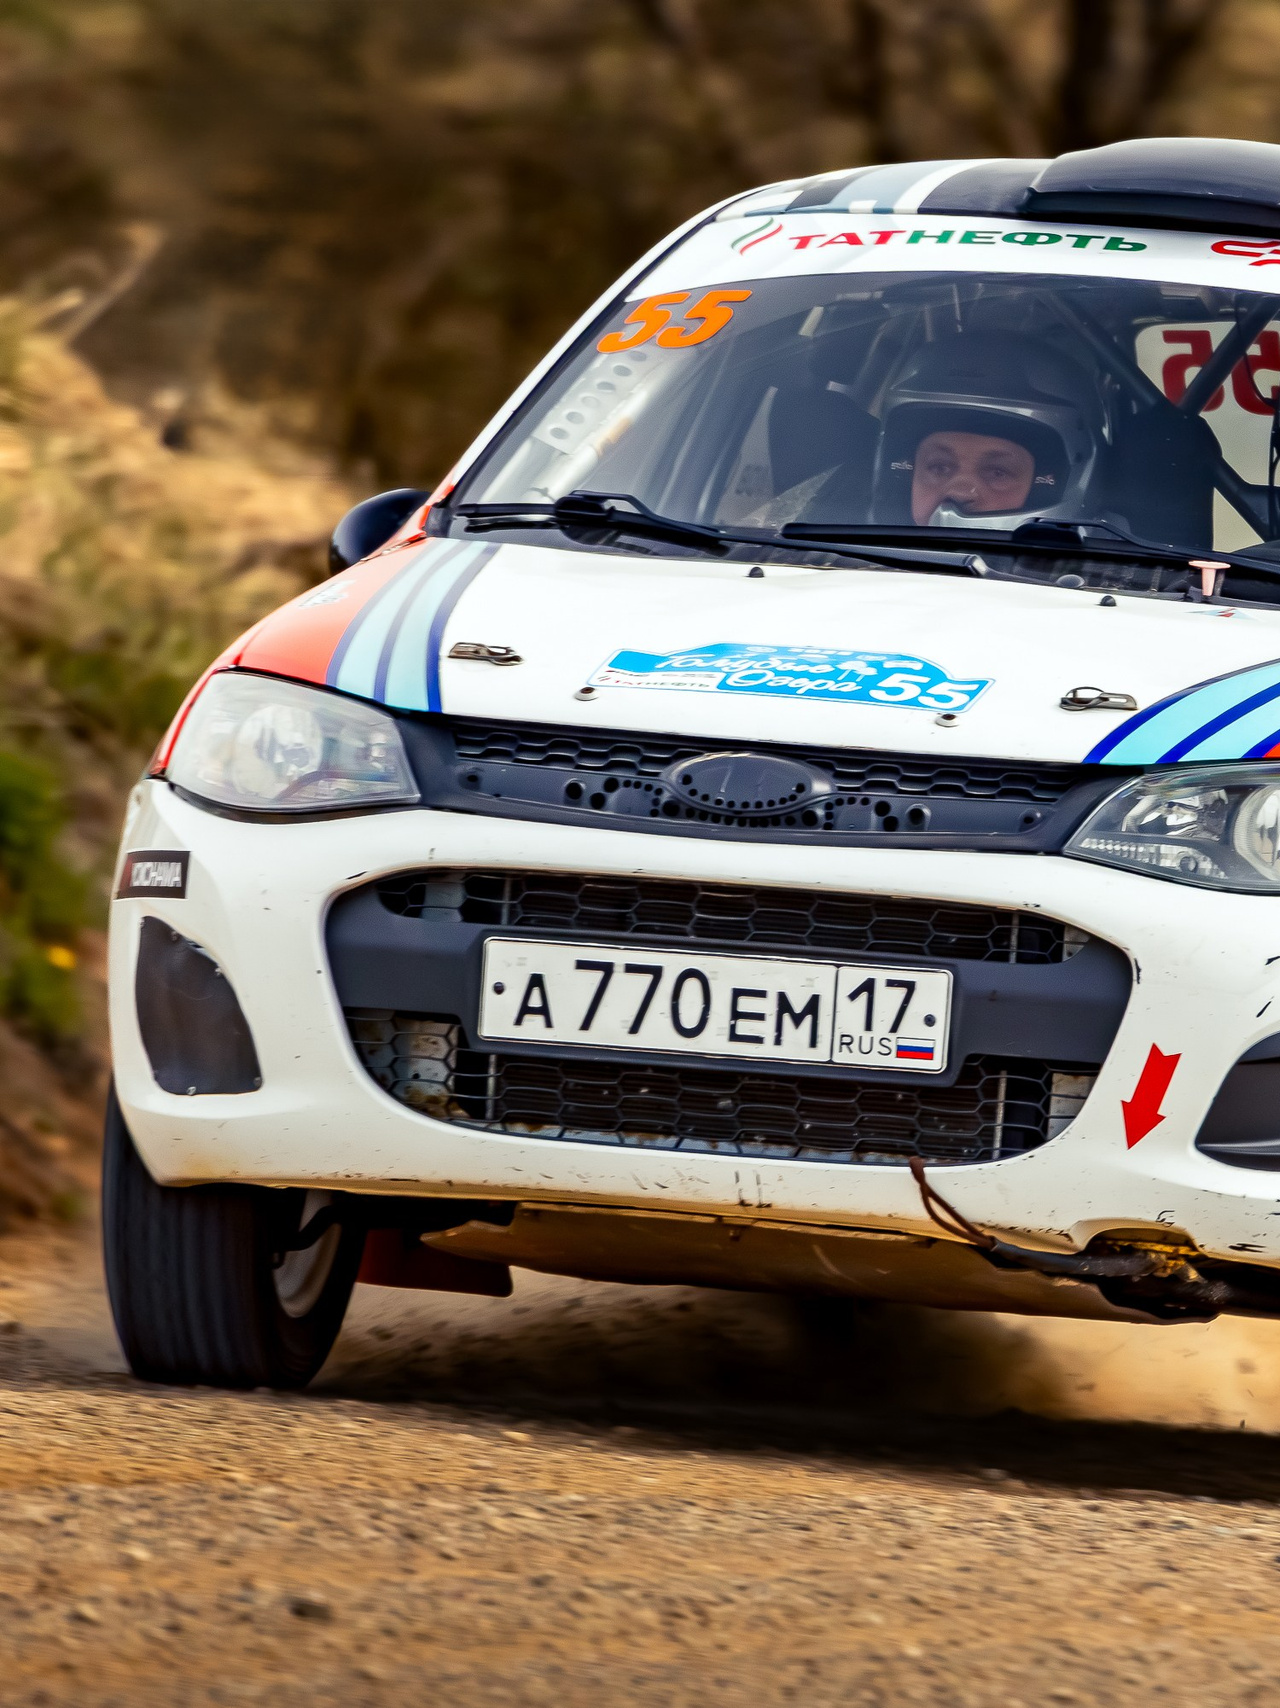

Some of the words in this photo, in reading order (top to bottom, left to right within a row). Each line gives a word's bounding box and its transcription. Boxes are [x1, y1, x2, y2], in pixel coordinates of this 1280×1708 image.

[788, 230, 1148, 252] ТАТНЕФТЬ
[596, 289, 753, 354] 55
[869, 673, 980, 710] 55
[846, 977, 917, 1034] 17
[838, 1033, 892, 1057] RUS
